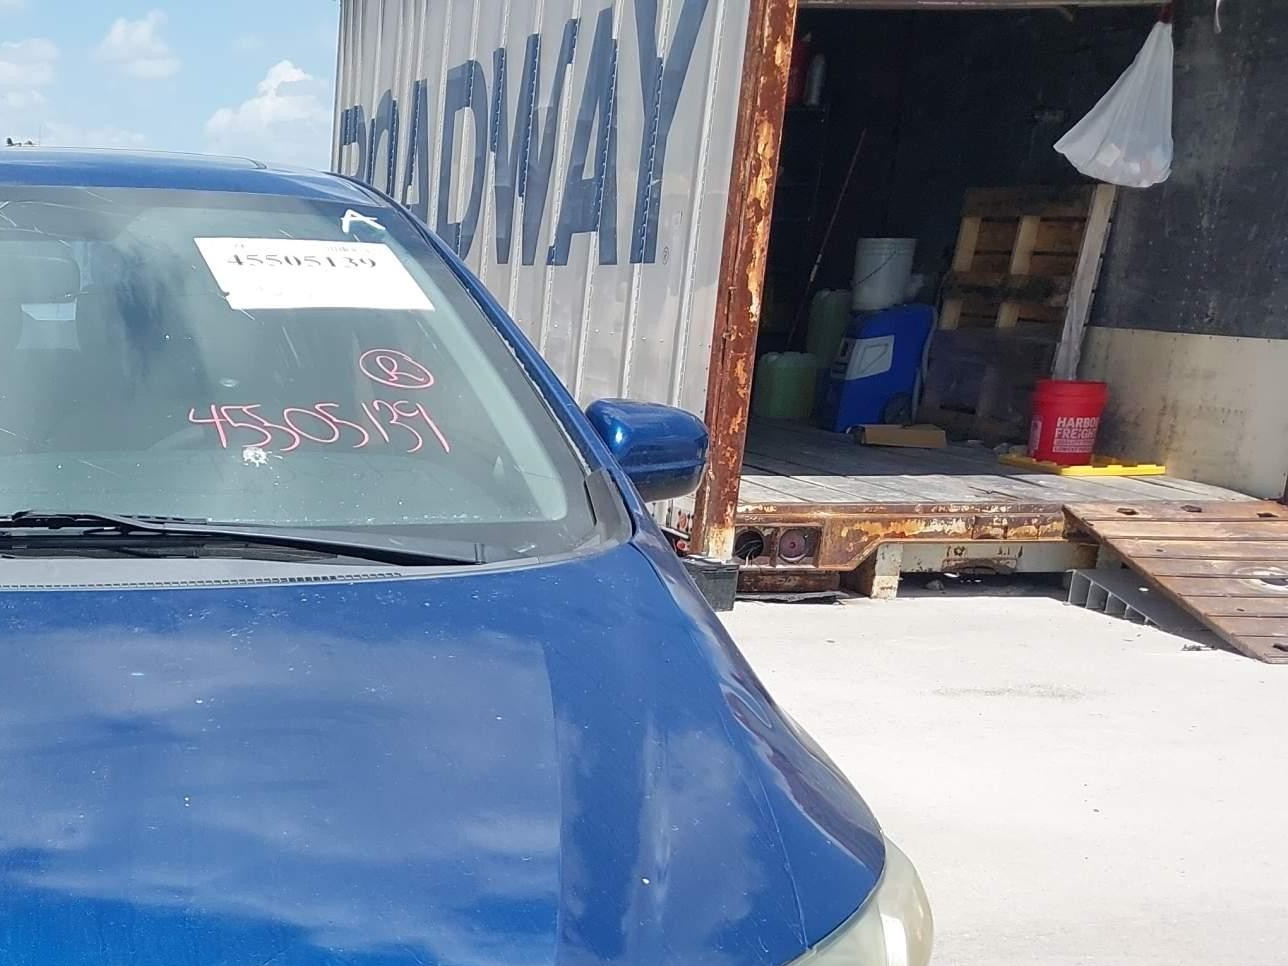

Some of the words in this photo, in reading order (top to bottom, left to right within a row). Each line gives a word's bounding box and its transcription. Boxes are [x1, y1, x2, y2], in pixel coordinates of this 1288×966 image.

[227, 253, 377, 268] 45505139
[188, 400, 450, 453] 45505139
[1056, 416, 1100, 429] HARBO
